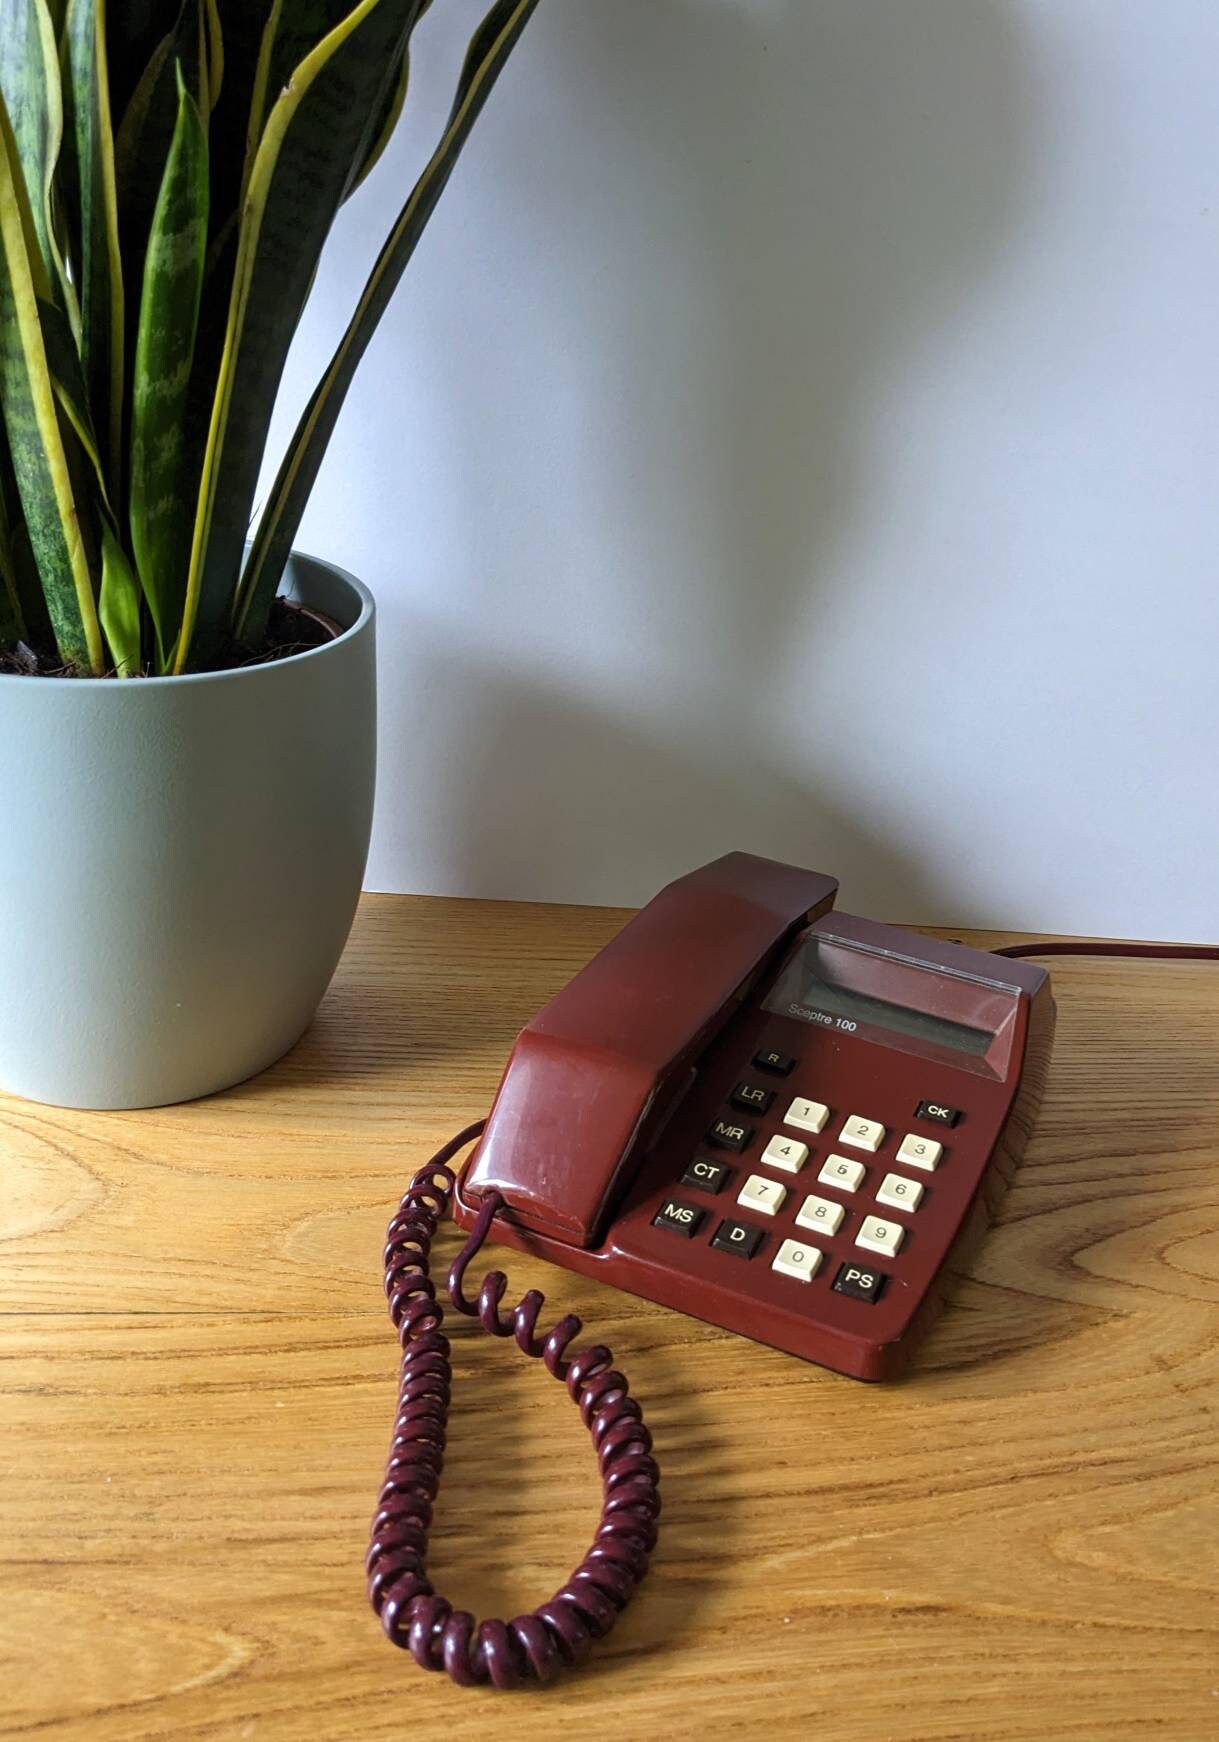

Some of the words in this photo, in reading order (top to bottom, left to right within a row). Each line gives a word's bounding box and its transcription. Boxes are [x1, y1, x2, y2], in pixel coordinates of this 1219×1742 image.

[788, 1003, 832, 1024] Sceptre
[836, 1018, 857, 1031] 100
[768, 1053, 780, 1063] R
[741, 1086, 765, 1102] LR
[927, 1105, 949, 1118] CK
[715, 1123, 744, 1140] MR
[857, 1125, 869, 1136] 2
[780, 1146, 791, 1156] 4
[914, 1144, 926, 1155] 3
[693, 1163, 719, 1179] CT
[837, 1164, 848, 1175] 5
[758, 1185, 769, 1196] 7
[895, 1184, 906, 1195] 6
[664, 1204, 693, 1223] MS
[815, 1206, 827, 1218] 8
[731, 1228, 745, 1241] D
[875, 1227, 887, 1239] 9
[792, 1251, 804, 1263] 0
[845, 1269, 874, 1288] PS
